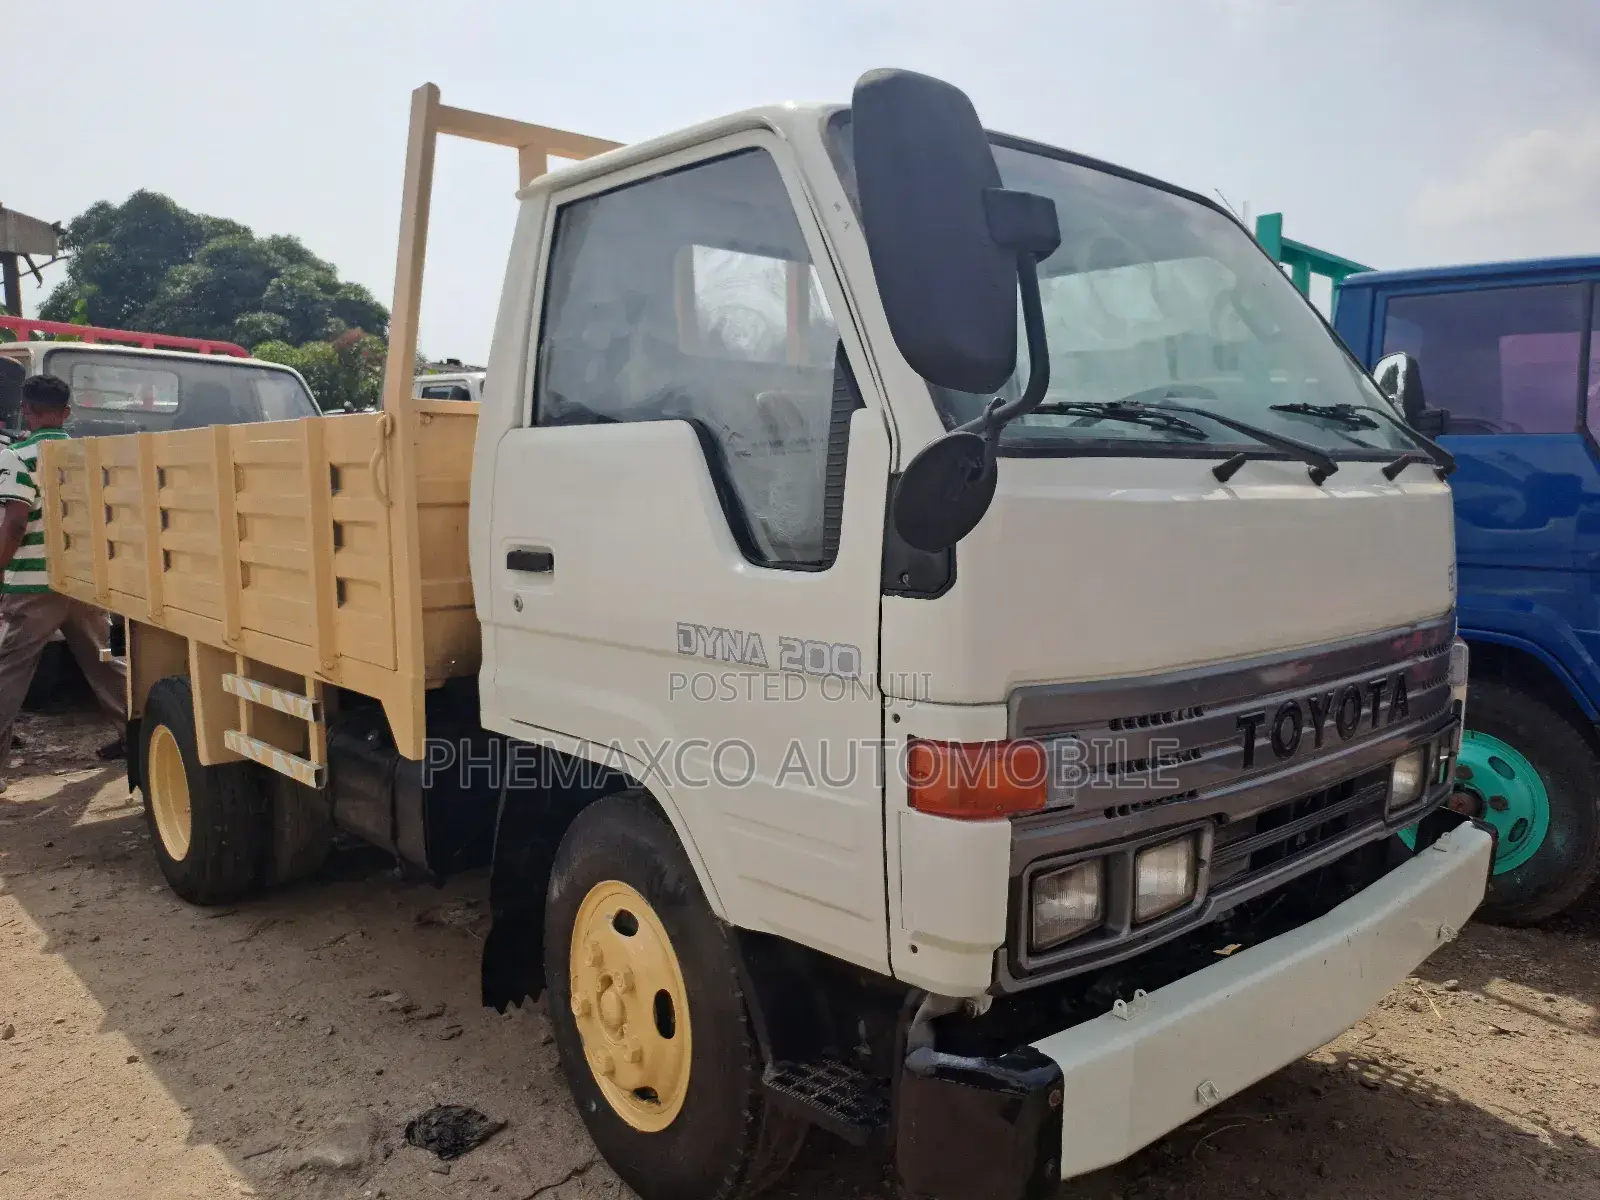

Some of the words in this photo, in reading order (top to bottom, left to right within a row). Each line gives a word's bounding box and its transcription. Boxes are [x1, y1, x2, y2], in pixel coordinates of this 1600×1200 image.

[677, 622, 769, 668] DYNA
[778, 636, 862, 681] 200
[1236, 671, 1410, 770] TOYOTA
